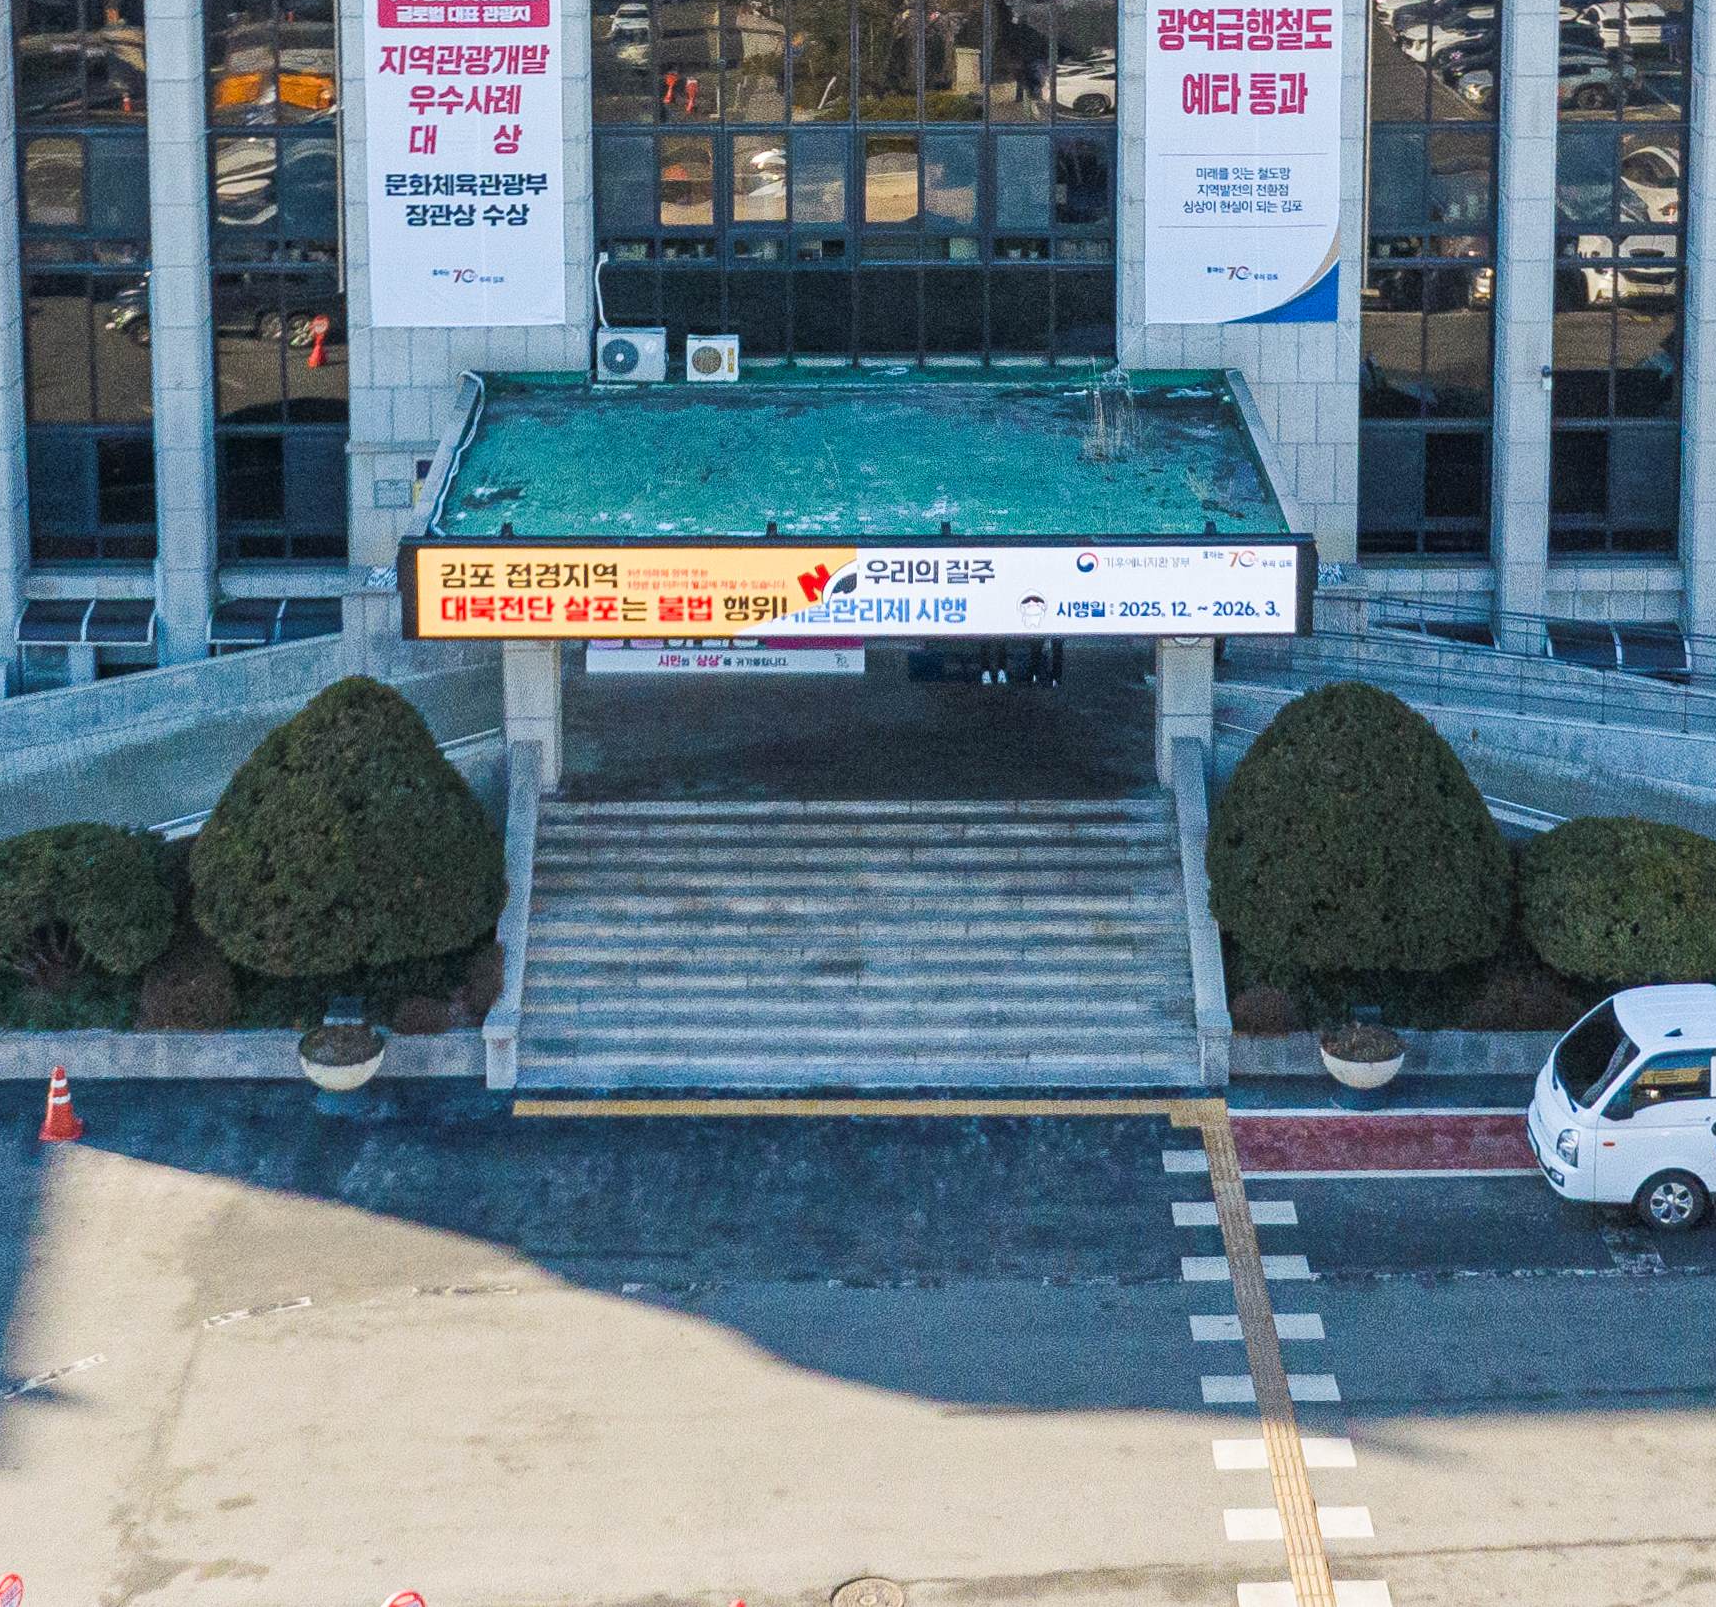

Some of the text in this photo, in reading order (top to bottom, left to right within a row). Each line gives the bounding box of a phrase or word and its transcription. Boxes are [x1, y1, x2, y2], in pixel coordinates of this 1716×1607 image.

[396, 5, 531, 22] 글로벌 대표 관광지
[1157, 7, 1333, 51] 광역급행철도
[379, 44, 550, 75] 지역관광개발
[408, 84, 522, 115] 우수사례
[1182, 72, 1309, 115] 예타 통과
[385, 173, 548, 197] 문화체육관광부
[1196, 167, 1291, 180] 미래를 잇는 철도망
[1197, 184, 1289, 197] 지역발전의 전환점
[405, 204, 530, 227] 장관상 수상
[1219, 200, 1253, 213] 현실이
[1255, 200, 1279, 213] 되는
[1281, 200, 1303, 213] 김포
[864, 559, 996, 584] 우리의 질주
[1103, 556, 1190, 569] 기후에너지환경부
[440, 562, 619, 590] 김포 접경지역
[440, 595, 788, 622] 대북전단 살포는 불법 행위!
[916, 597, 967, 623] 시행
[1118, 601, 1166, 617] 2025.
[1171, 601, 1192, 617] 12.
[1212, 601, 1261, 617] 2026.
[1265, 601, 1281, 617] 3.
